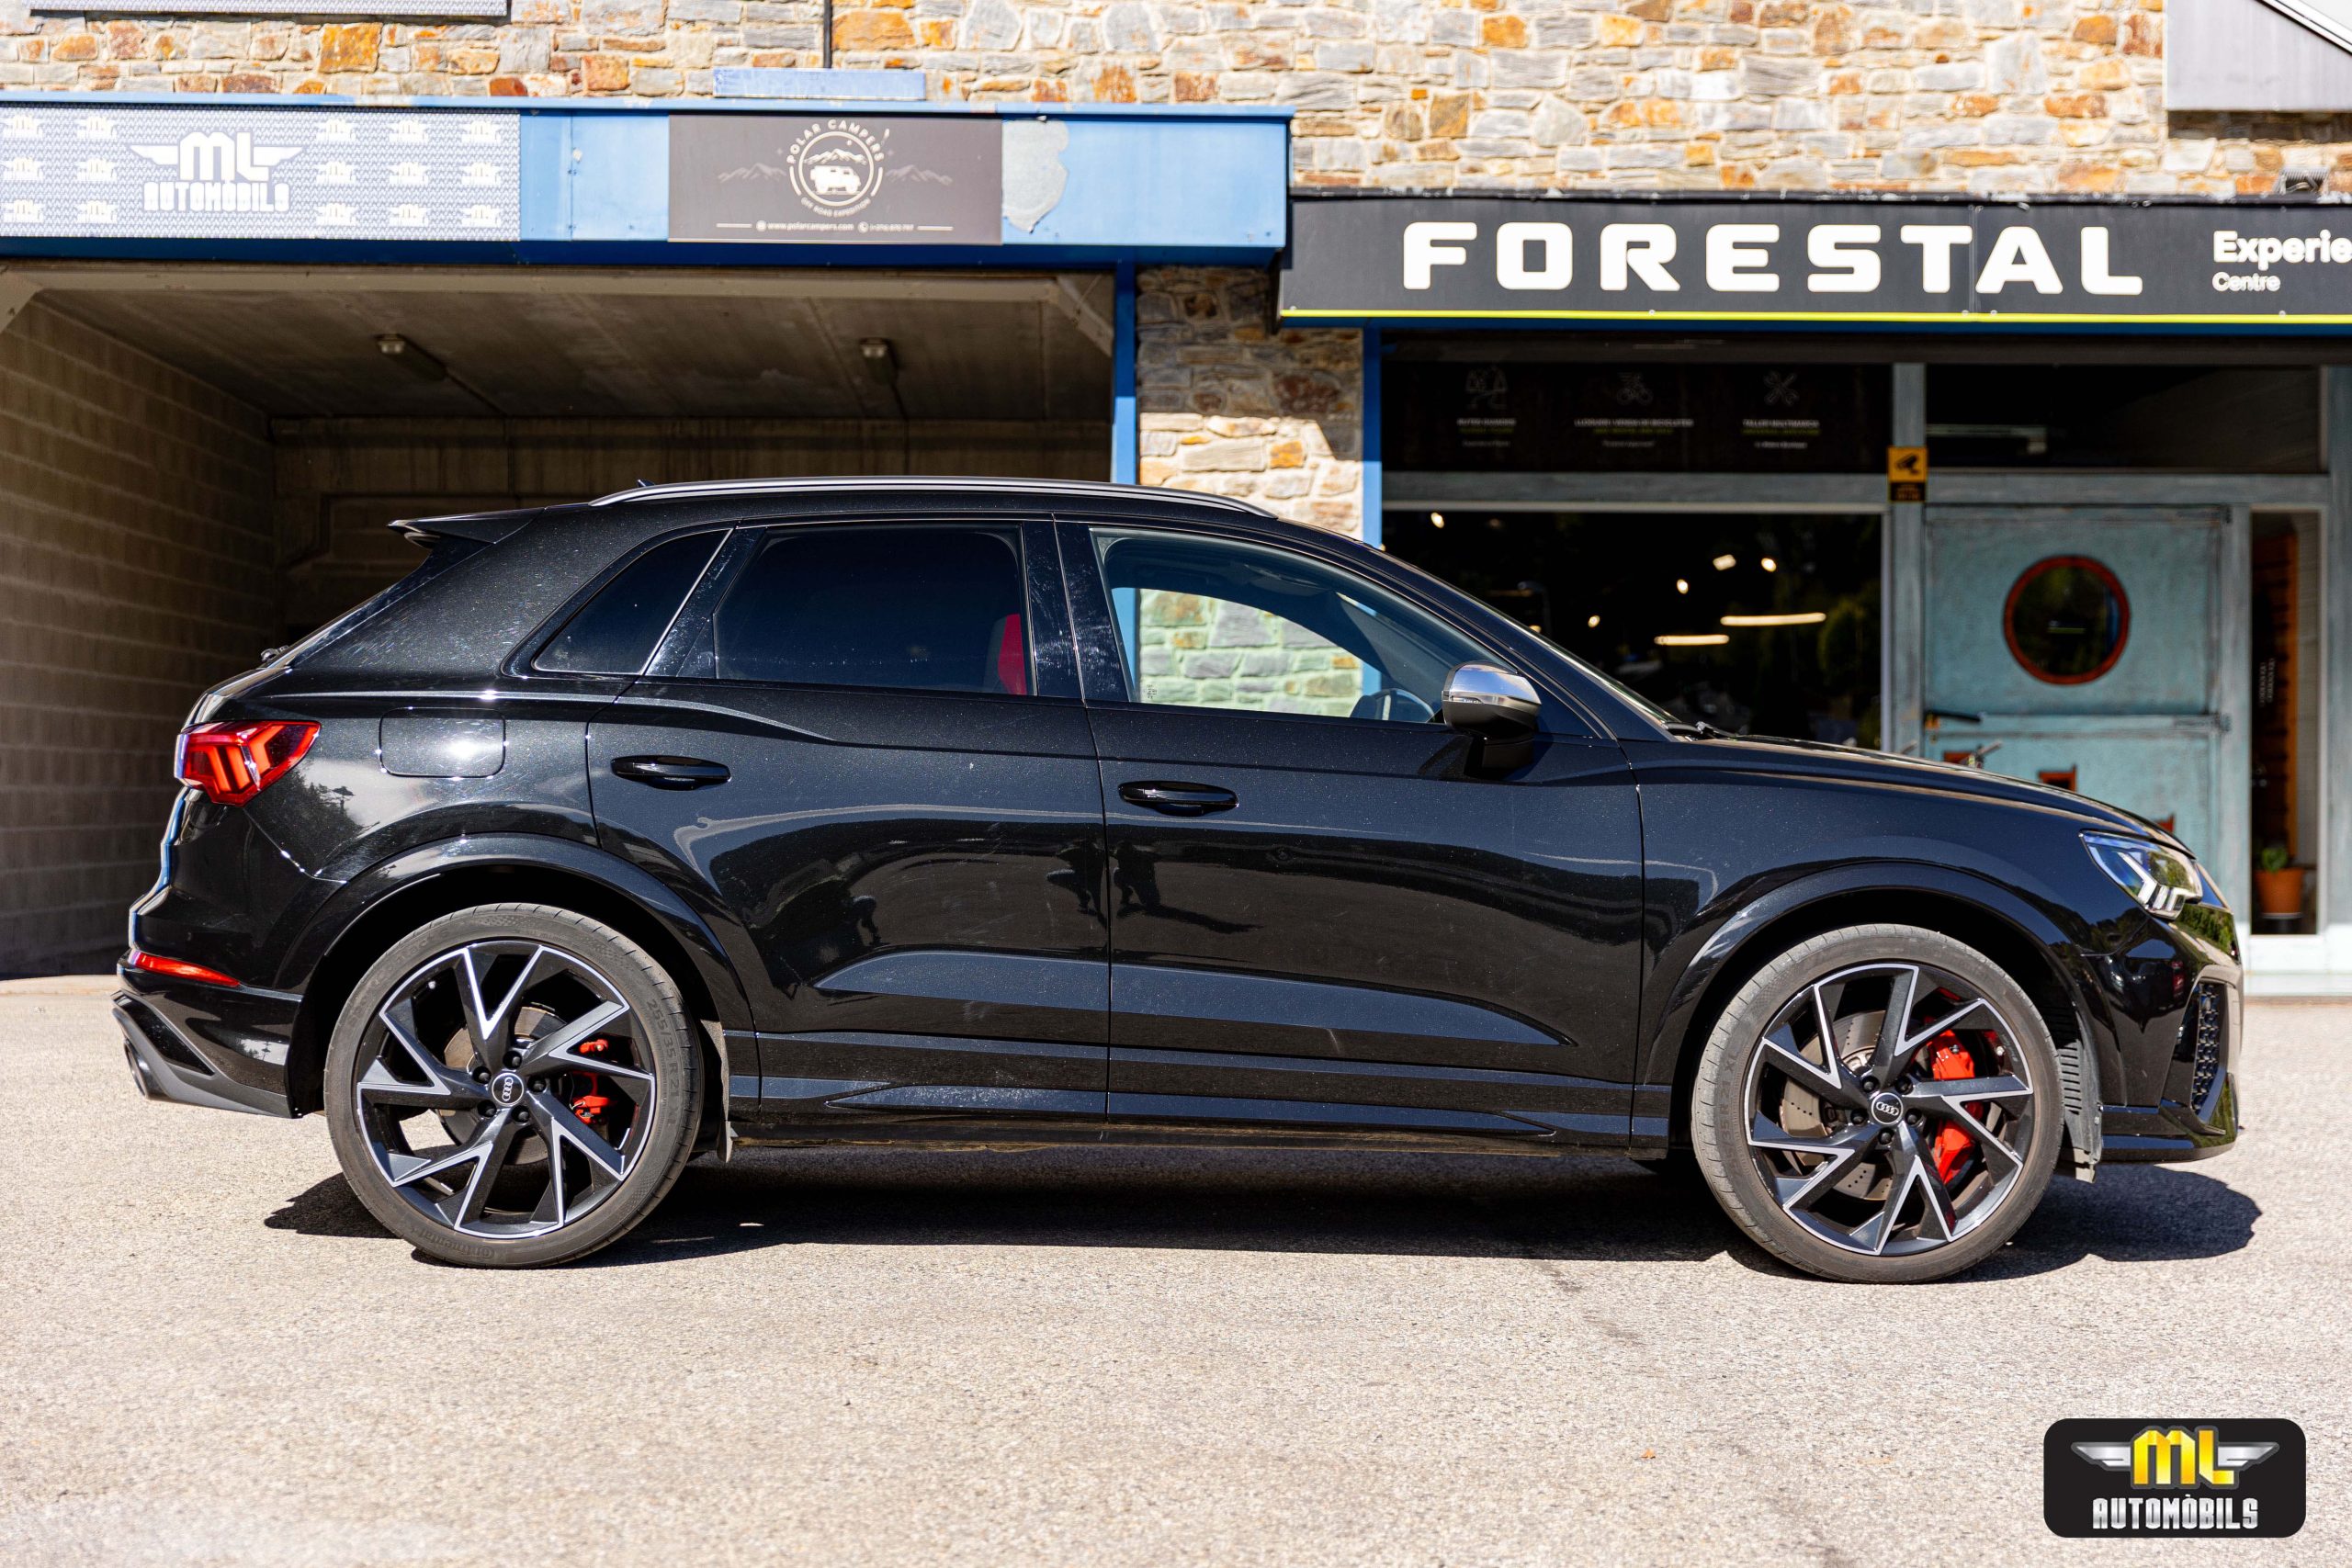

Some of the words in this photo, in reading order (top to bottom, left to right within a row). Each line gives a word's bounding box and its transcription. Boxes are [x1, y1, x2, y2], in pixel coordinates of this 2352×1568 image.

[179, 131, 269, 182] ML
[786, 123, 821, 164] POLAR
[828, 119, 884, 162] CAMPERS
[1403, 221, 2143, 295] FORESTAL
[2211, 271, 2281, 292] Centre
[646, 998, 677, 1057] 255/35
